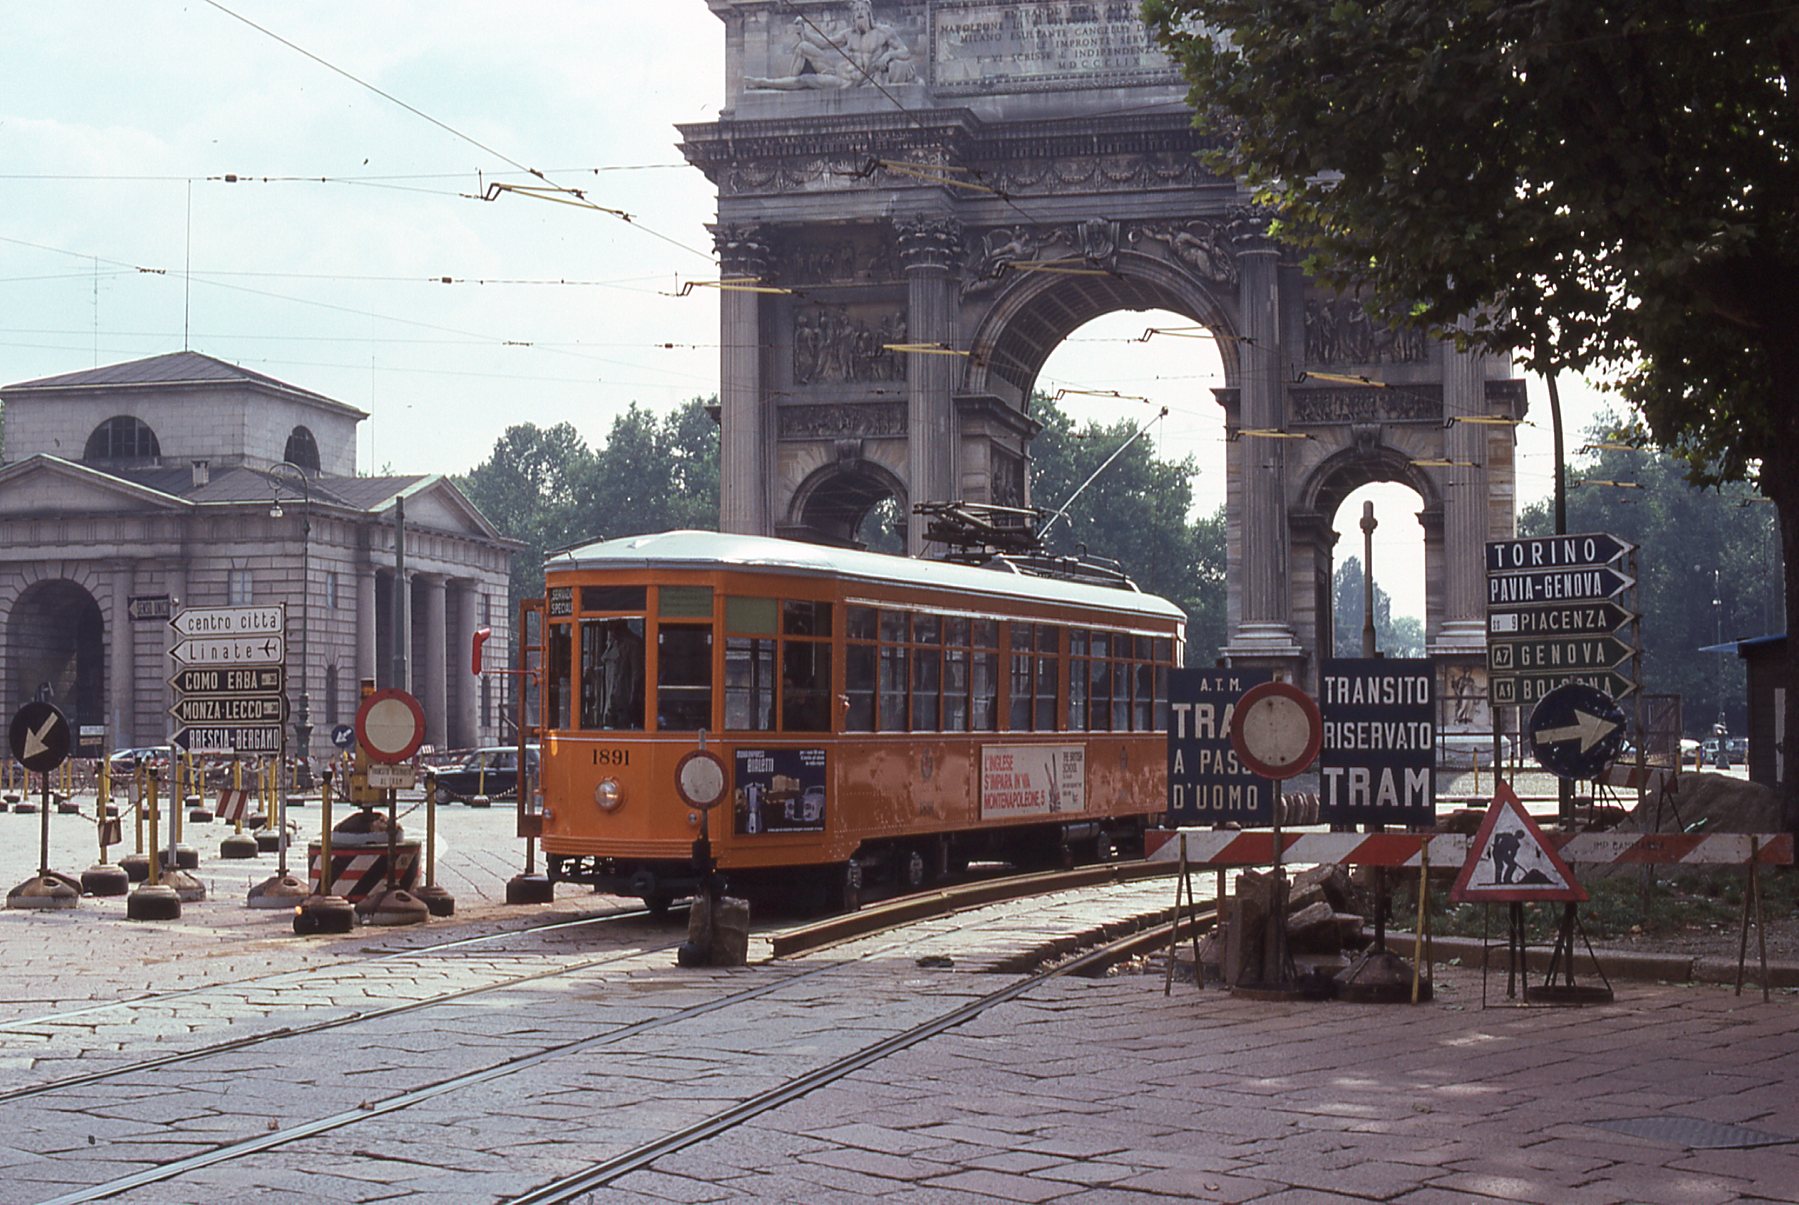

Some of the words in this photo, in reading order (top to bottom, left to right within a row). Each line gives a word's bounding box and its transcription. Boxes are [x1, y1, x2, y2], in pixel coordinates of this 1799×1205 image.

[960, 33, 1002, 43] MILANO
[1056, 37, 1111, 48] IMPRONTE
[1012, 51, 1051, 62] SCRISSE
[1074, 46, 1159, 59] INDIPENDENZA
[1494, 538, 1596, 568] TORINO
[1491, 572, 1602, 602] PAVIA-GENOVA
[188, 614, 231, 631] centro
[240, 611, 278, 629] città
[1511, 615, 1517, 630] 9
[1520, 610, 1607, 631] PIACENZA
[190, 643, 252, 661] Linate
[1495, 649, 1508, 664] A7
[1521, 642, 1605, 666] GENOVA
[185, 672, 218, 690] COMO
[227, 671, 258, 689] ERBA
[1324, 676, 1429, 705] TRANSITO
[1499, 684, 1512, 697] A1
[1172, 703, 1234, 739] TRA
[1323, 722, 1431, 750] RISERVATO
[592, 749, 630, 766] 1891
[1173, 749, 1185, 775] A
[1173, 783, 1259, 811] D'UOMO
[1322, 767, 1430, 808] TRAM
